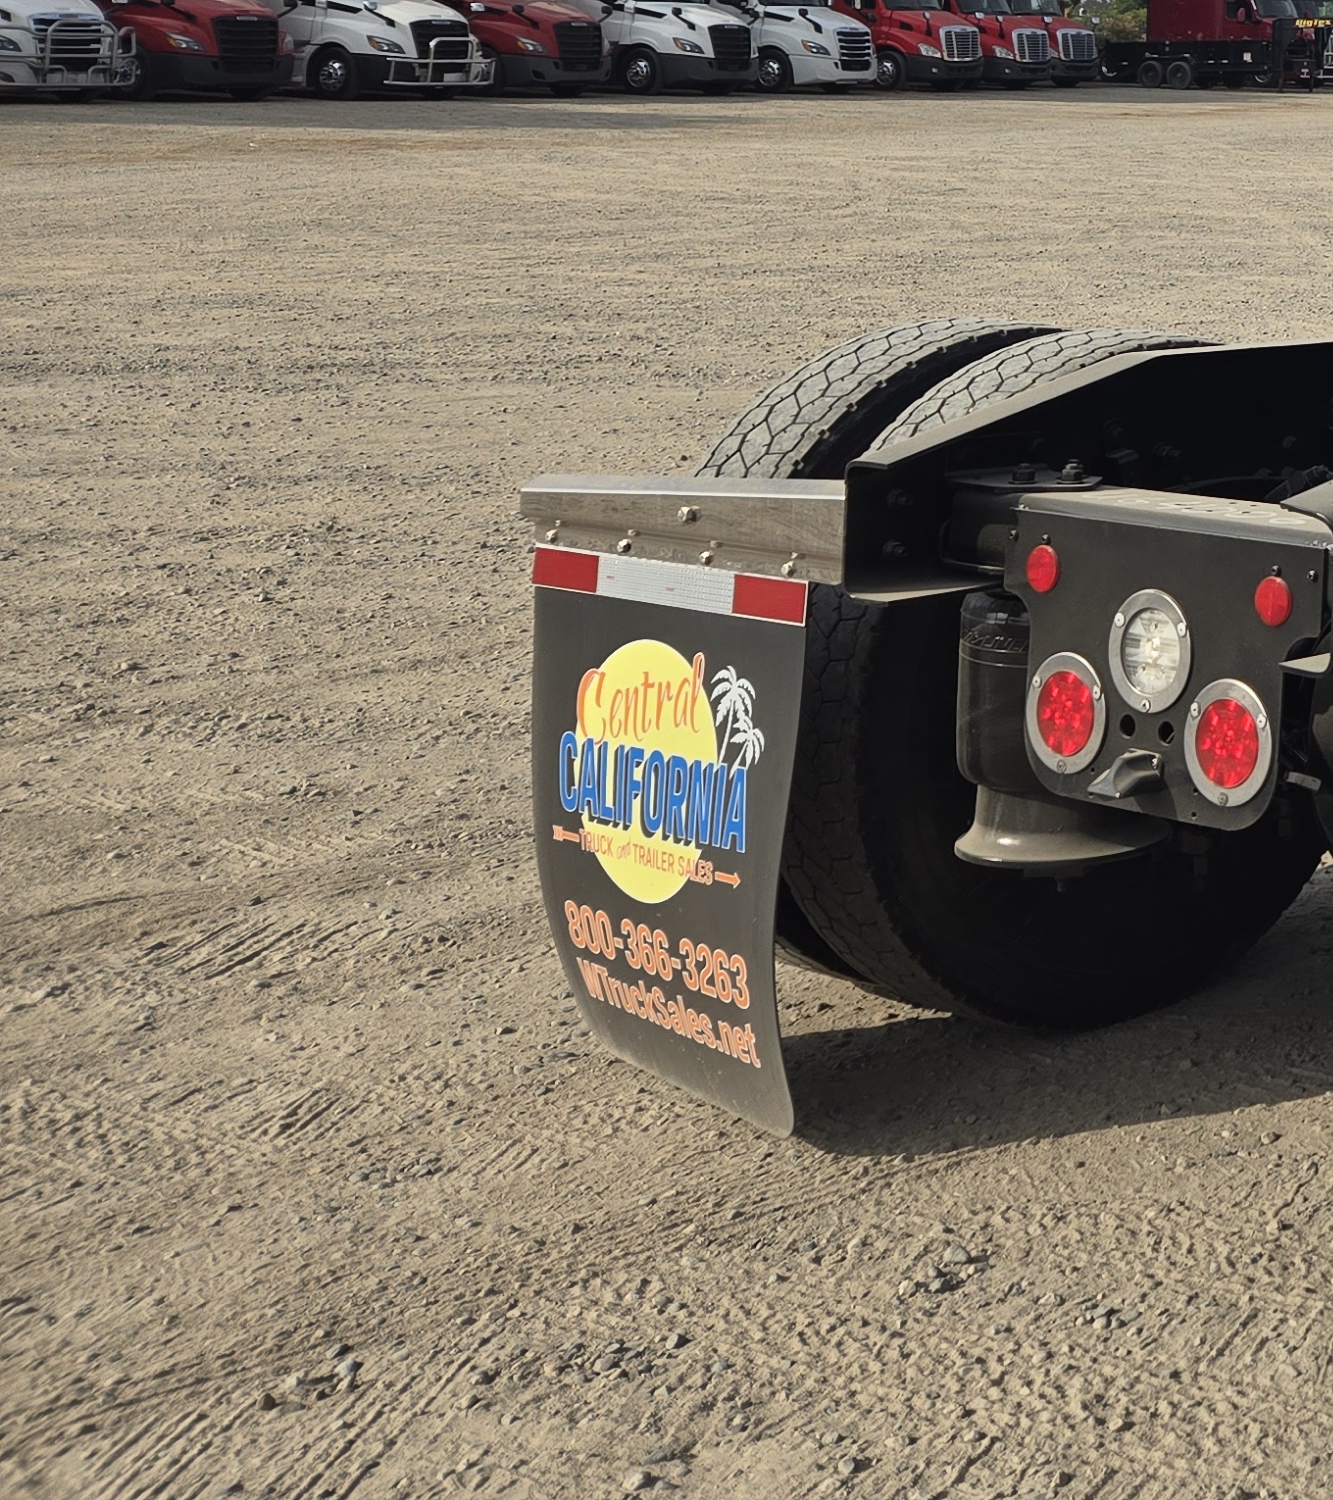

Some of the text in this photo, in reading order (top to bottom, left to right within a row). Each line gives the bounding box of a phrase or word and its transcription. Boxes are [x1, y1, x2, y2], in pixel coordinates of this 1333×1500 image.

[576, 651, 705, 746] Central
[559, 731, 747, 854] CALIFORNIA
[578, 828, 714, 886] TRUCK and TRAILER SALES
[564, 900, 750, 1010] 800-366-3263
[576, 956, 761, 1068] WTruckSales.net
